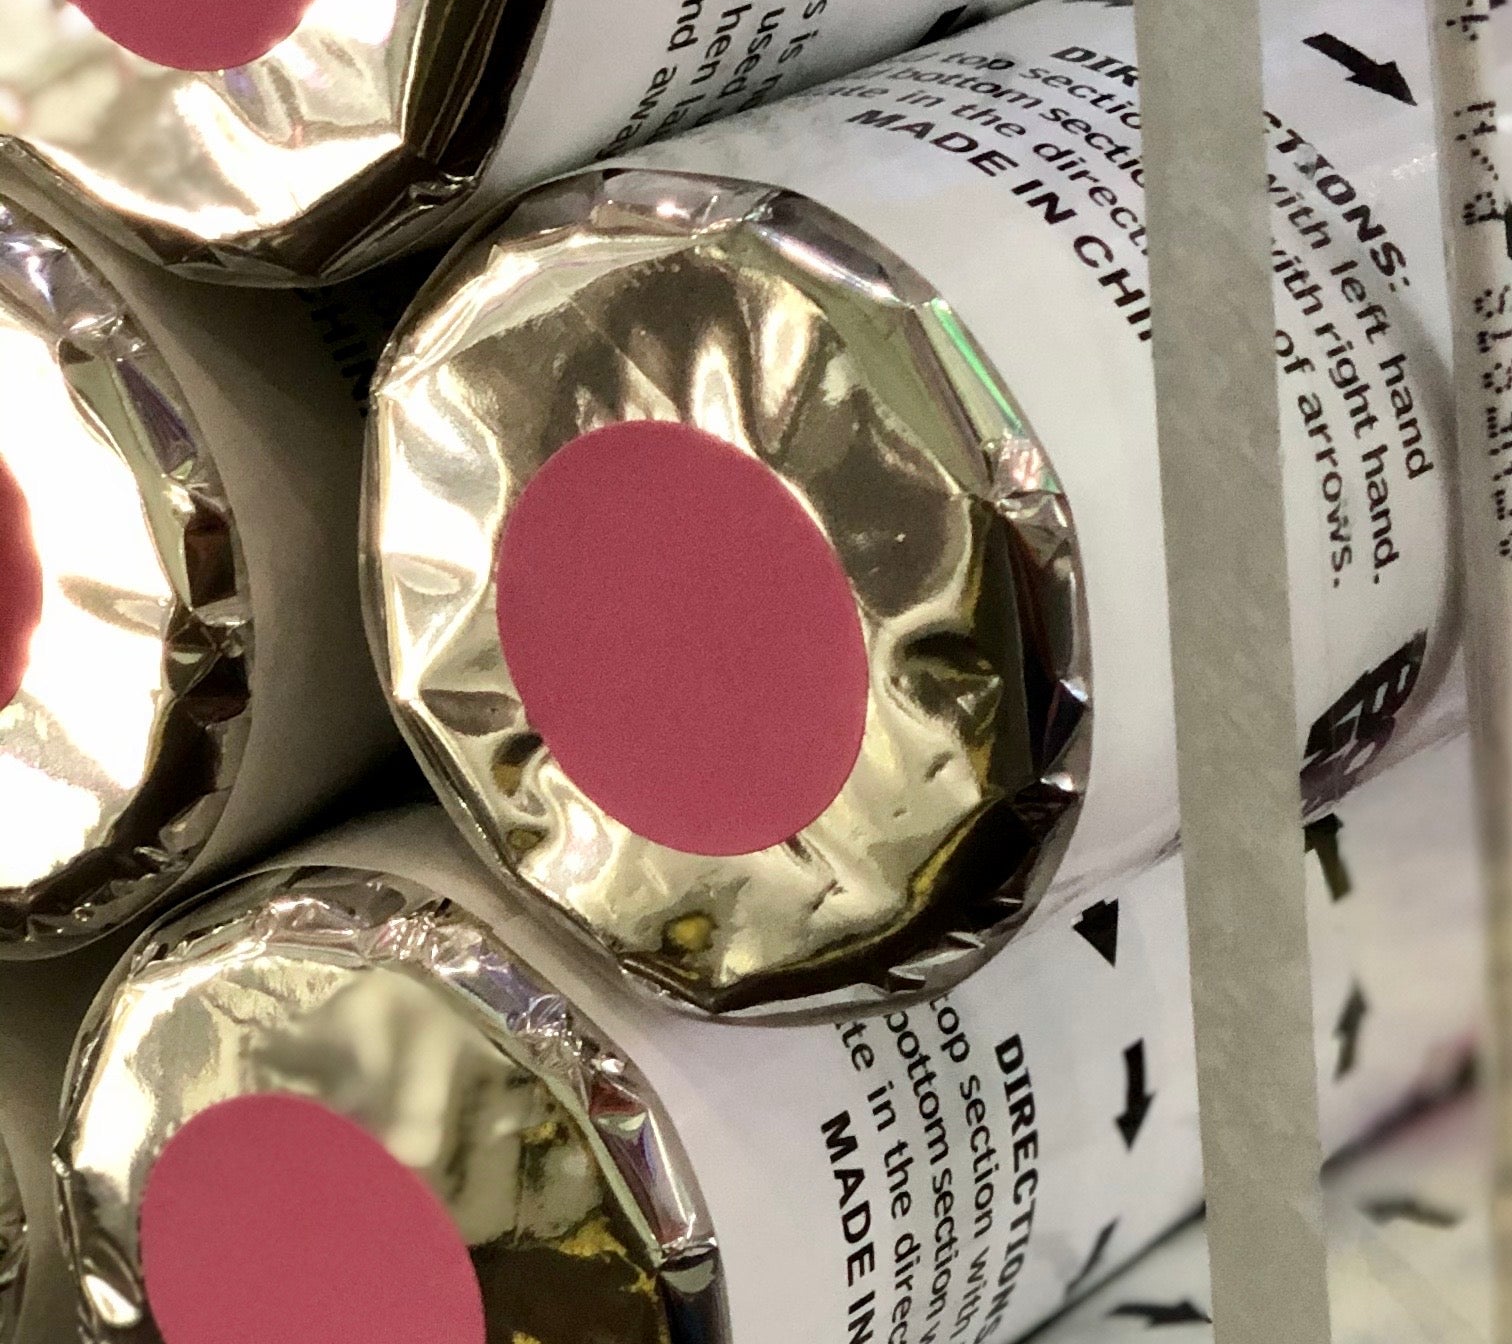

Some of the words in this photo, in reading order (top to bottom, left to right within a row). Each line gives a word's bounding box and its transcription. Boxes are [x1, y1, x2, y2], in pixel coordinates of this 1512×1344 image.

[716, 7, 786, 100] used
[777, 28, 820, 65] is
[845, 109, 1021, 178] MADE
[1010, 178, 1078, 226] IN
[889, 66, 1043, 109] bottom
[1314, 322, 1379, 440] right
[1360, 443, 1400, 585] hand.
[895, 89, 946, 108] in
[950, 103, 1027, 139] the
[1298, 391, 1353, 589] arrows.
[1329, 259, 1391, 345] left
[1378, 353, 1435, 480] hand
[820, 1109, 876, 1288] MADE
[866, 1079, 897, 1133] in
[883, 1138, 914, 1221] the
[959, 1073, 1000, 1240] section
[926, 1166, 960, 1322] section
[950, 1245, 990, 1340] with
